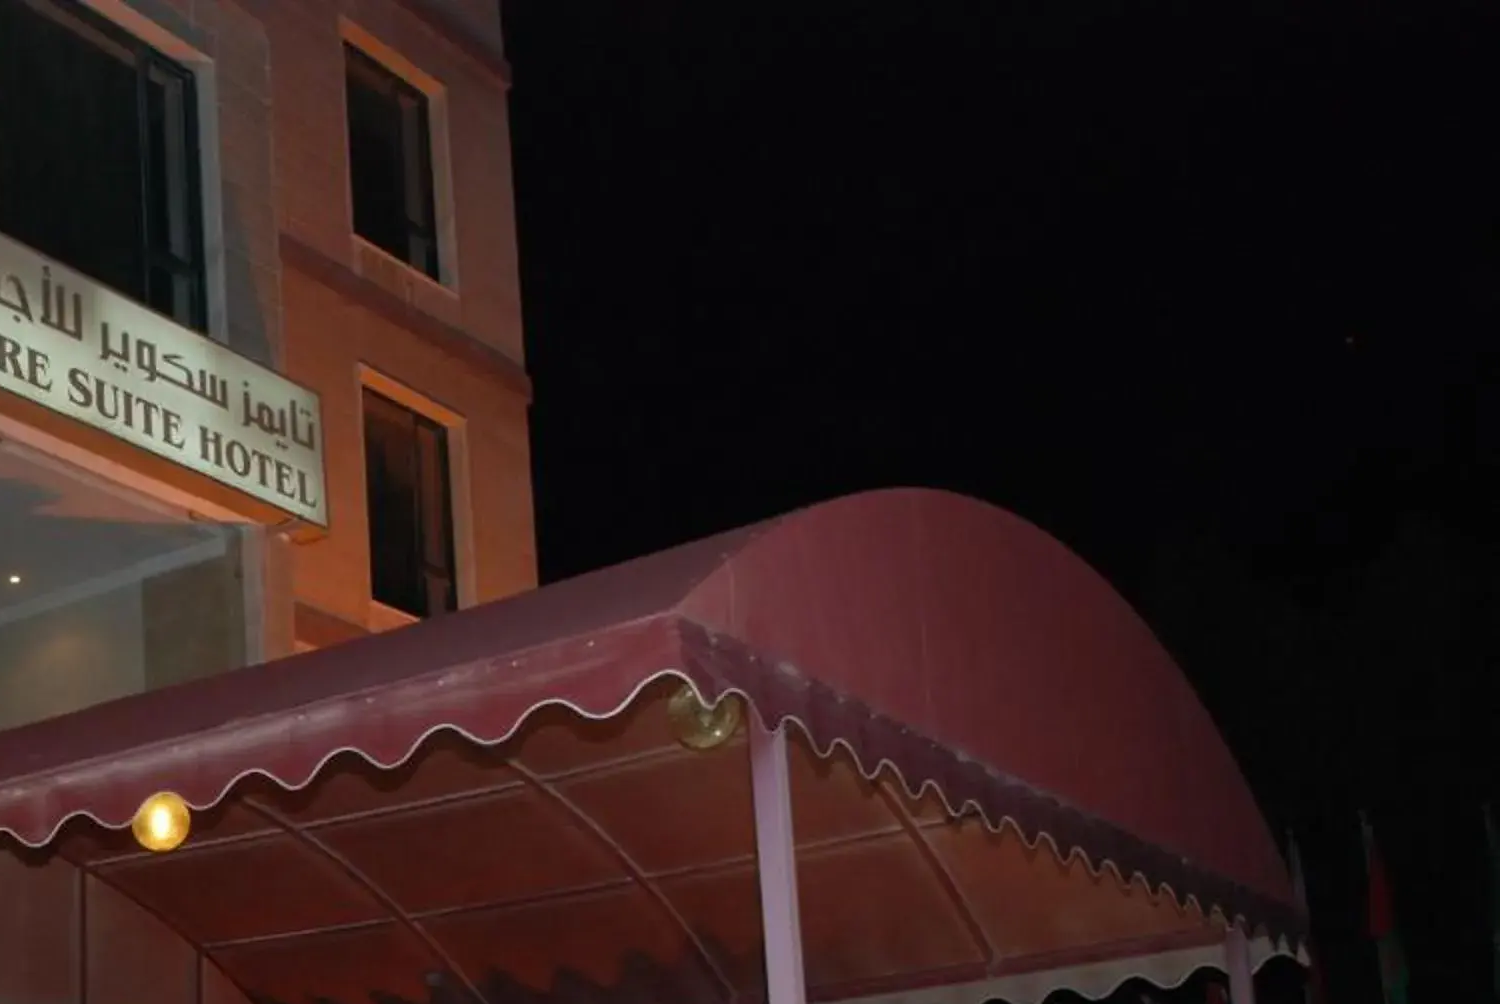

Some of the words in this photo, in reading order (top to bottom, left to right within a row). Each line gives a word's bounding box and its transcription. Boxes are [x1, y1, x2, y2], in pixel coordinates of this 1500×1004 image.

[100, 322, 229, 411] سكوير
[67, 367, 186, 449] SUITE
[198, 425, 317, 509] HOTEL
[242, 381, 315, 450] تايمز
